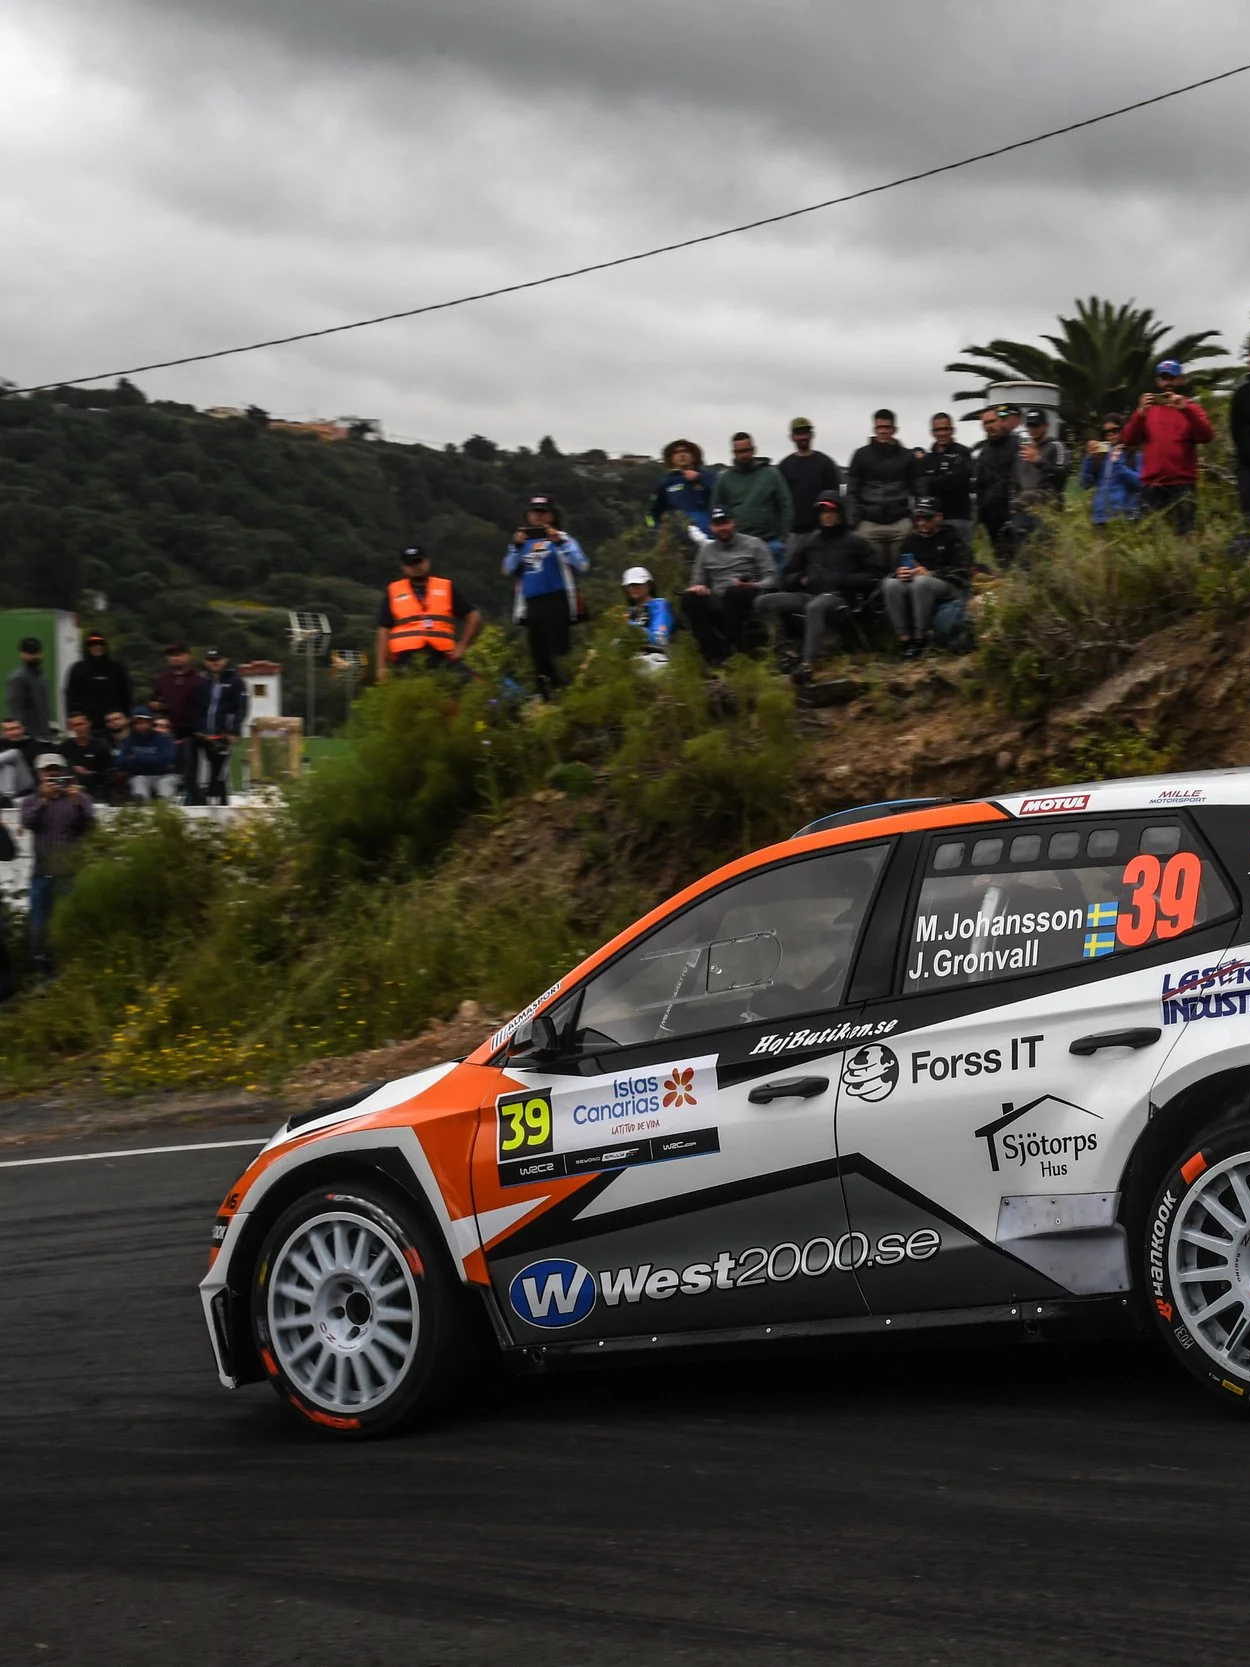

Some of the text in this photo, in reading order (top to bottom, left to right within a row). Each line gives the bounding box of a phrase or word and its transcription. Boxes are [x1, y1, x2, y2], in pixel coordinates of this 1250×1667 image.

[1023, 795, 1089, 812] MOTUL
[1149, 796, 1208, 805] MOTORSPORT
[1158, 789, 1203, 798] MILLE
[1116, 852, 1203, 946] 39
[911, 1035, 1044, 1084] Forss IT
[613, 1075, 660, 1099] Islas
[573, 1095, 660, 1126] Canarias
[500, 1098, 551, 1151] 39
[611, 1118, 661, 1136] LATITUD DE VIDA
[1002, 1131, 1099, 1167] Sjötorps
[519, 1162, 555, 1177] WRC2
[1040, 1160, 1069, 1179] Hus
[599, 1228, 941, 1307] West2000.se
[521, 1260, 590, 1320] W
